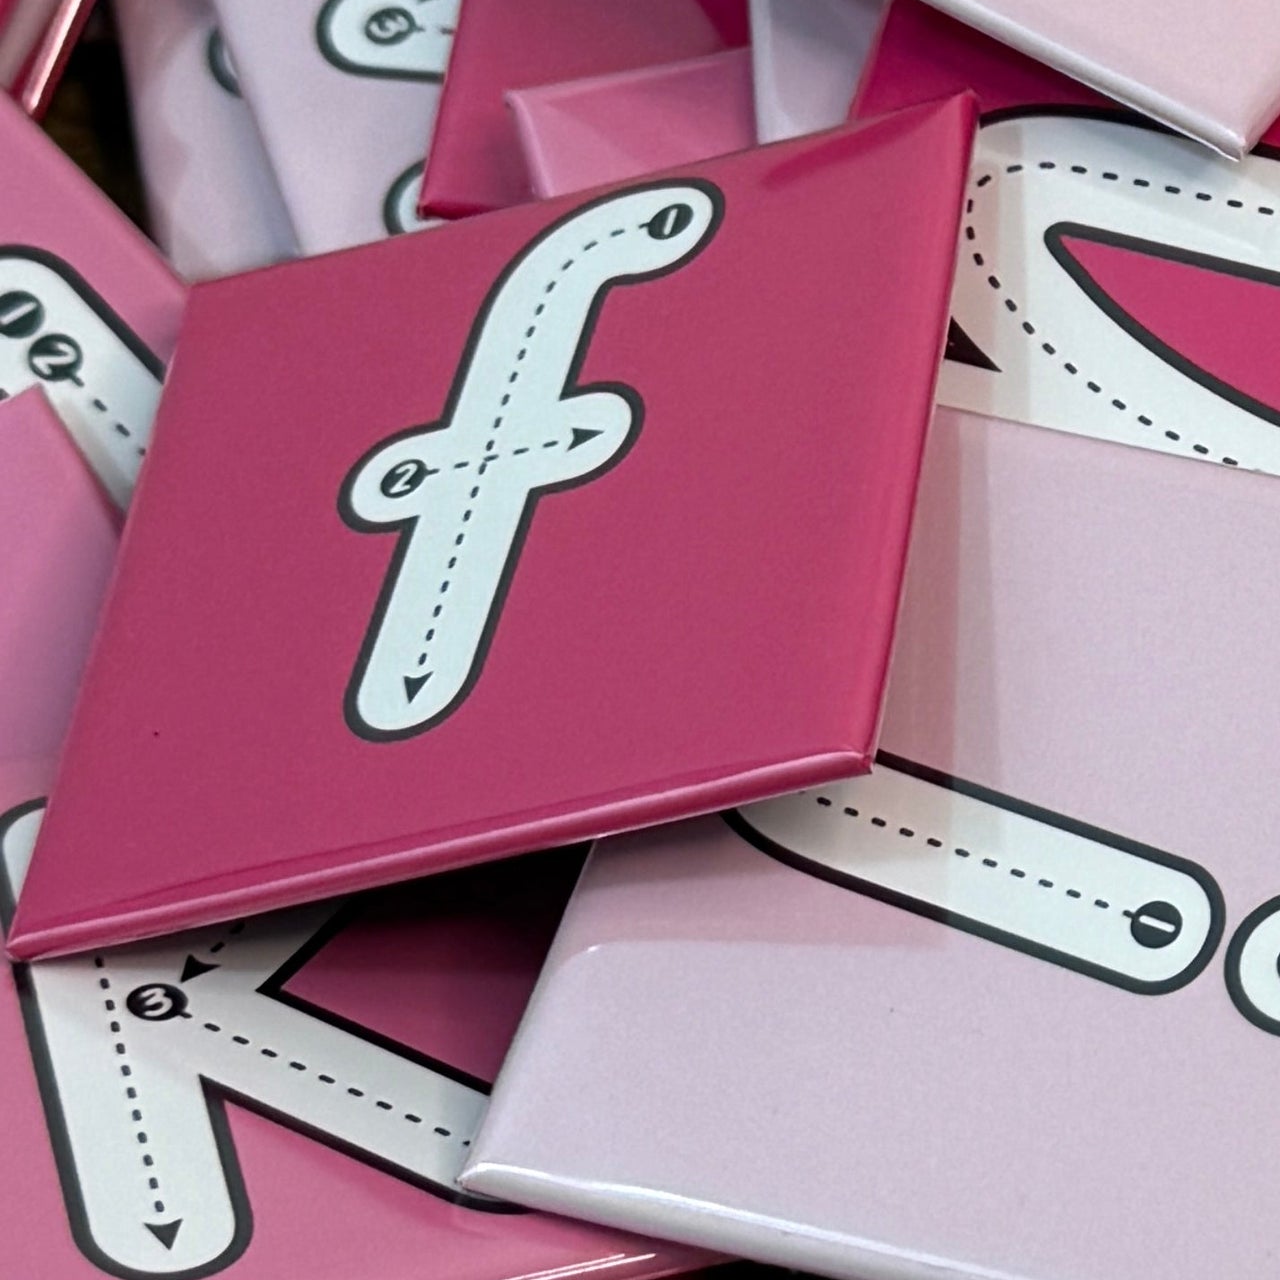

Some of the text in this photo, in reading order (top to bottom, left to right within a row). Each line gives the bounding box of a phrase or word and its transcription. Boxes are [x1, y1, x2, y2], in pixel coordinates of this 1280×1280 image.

[29, 335, 81, 378] 2
[337, 176, 725, 744] f
[384, 460, 423, 497] 2
